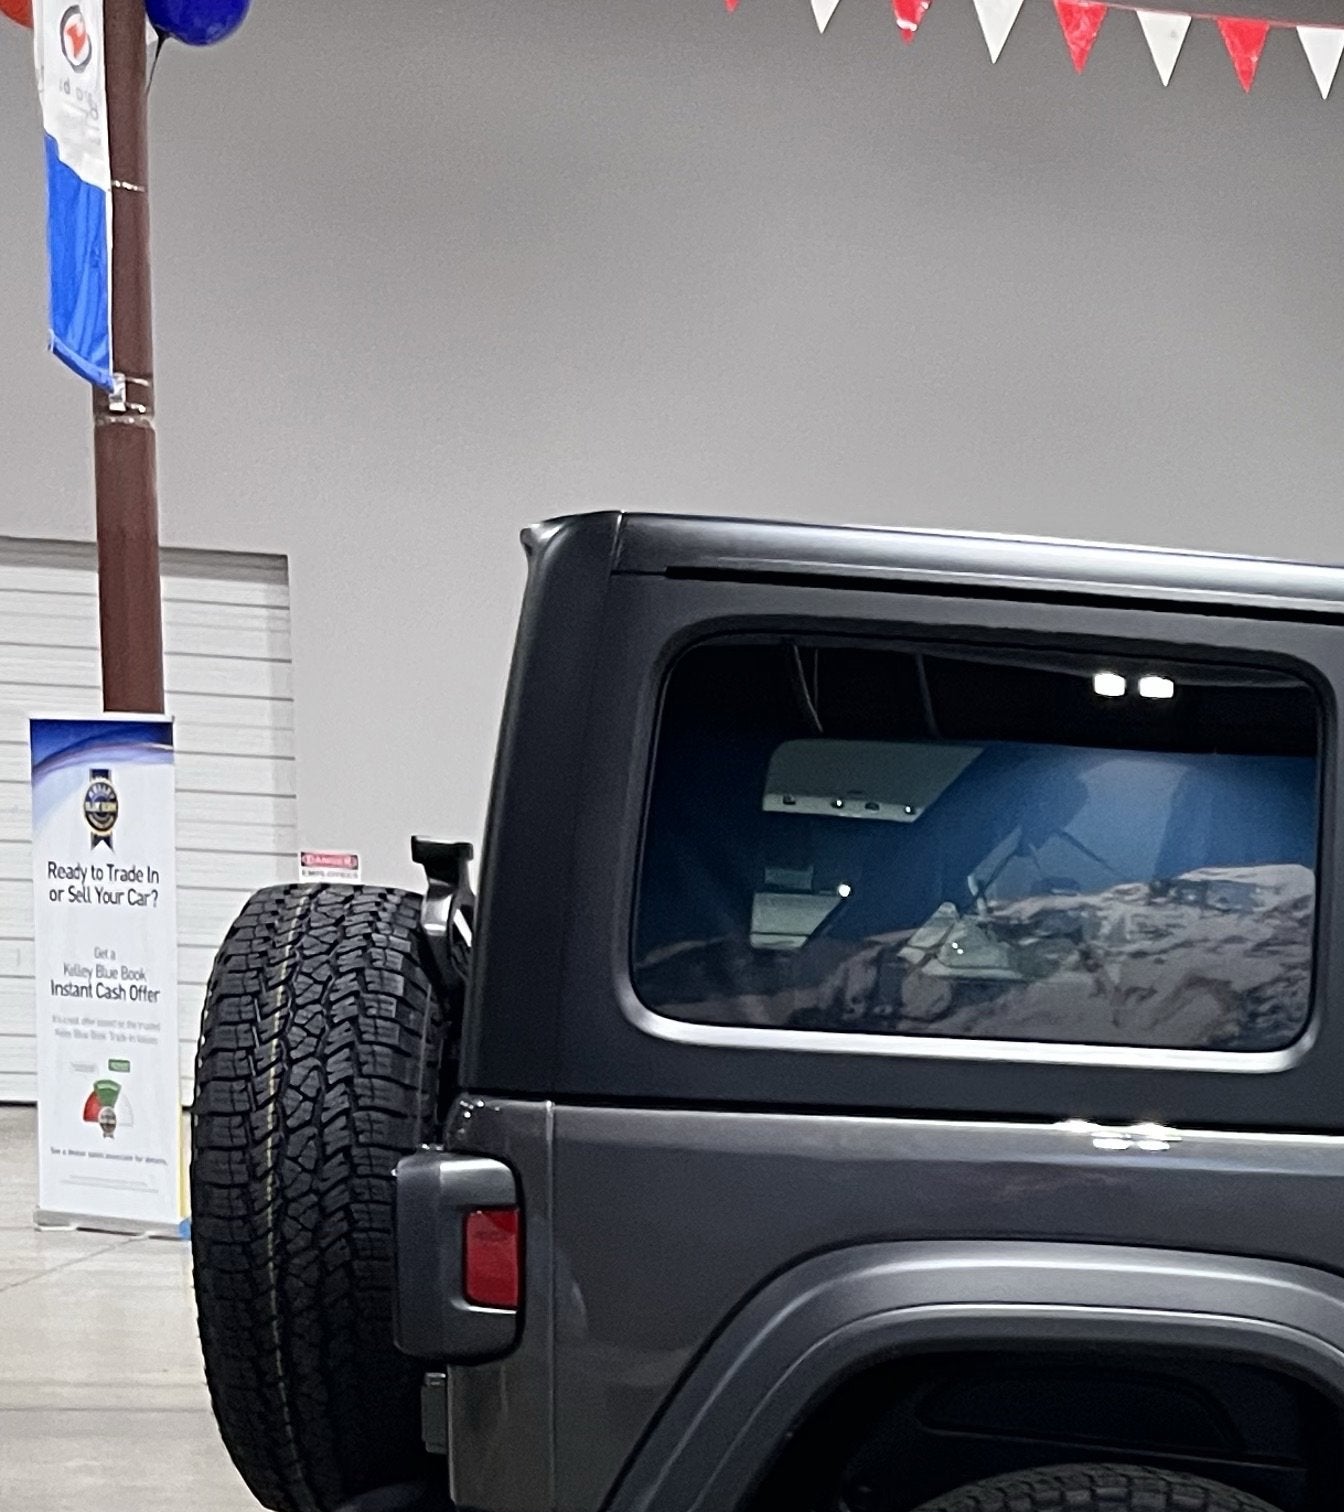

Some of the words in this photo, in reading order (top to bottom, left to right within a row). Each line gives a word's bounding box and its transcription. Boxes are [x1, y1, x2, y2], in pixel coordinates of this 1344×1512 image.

[48, 861, 87, 884] Ready
[91, 865, 104, 881] to
[106, 863, 144, 882] Trade
[147, 866, 160, 883] In
[49, 889, 65, 902] or
[68, 885, 91, 903] Sell
[95, 886, 124, 904] Your
[127, 888, 158, 907] Car?
[63, 962, 93, 981] Kelley
[95, 964, 119, 979] Blue
[121, 966, 147, 982] Book
[50, 979, 93, 999] Instant
[96, 982, 127, 1001] Cash
[129, 984, 160, 1003] Offer
